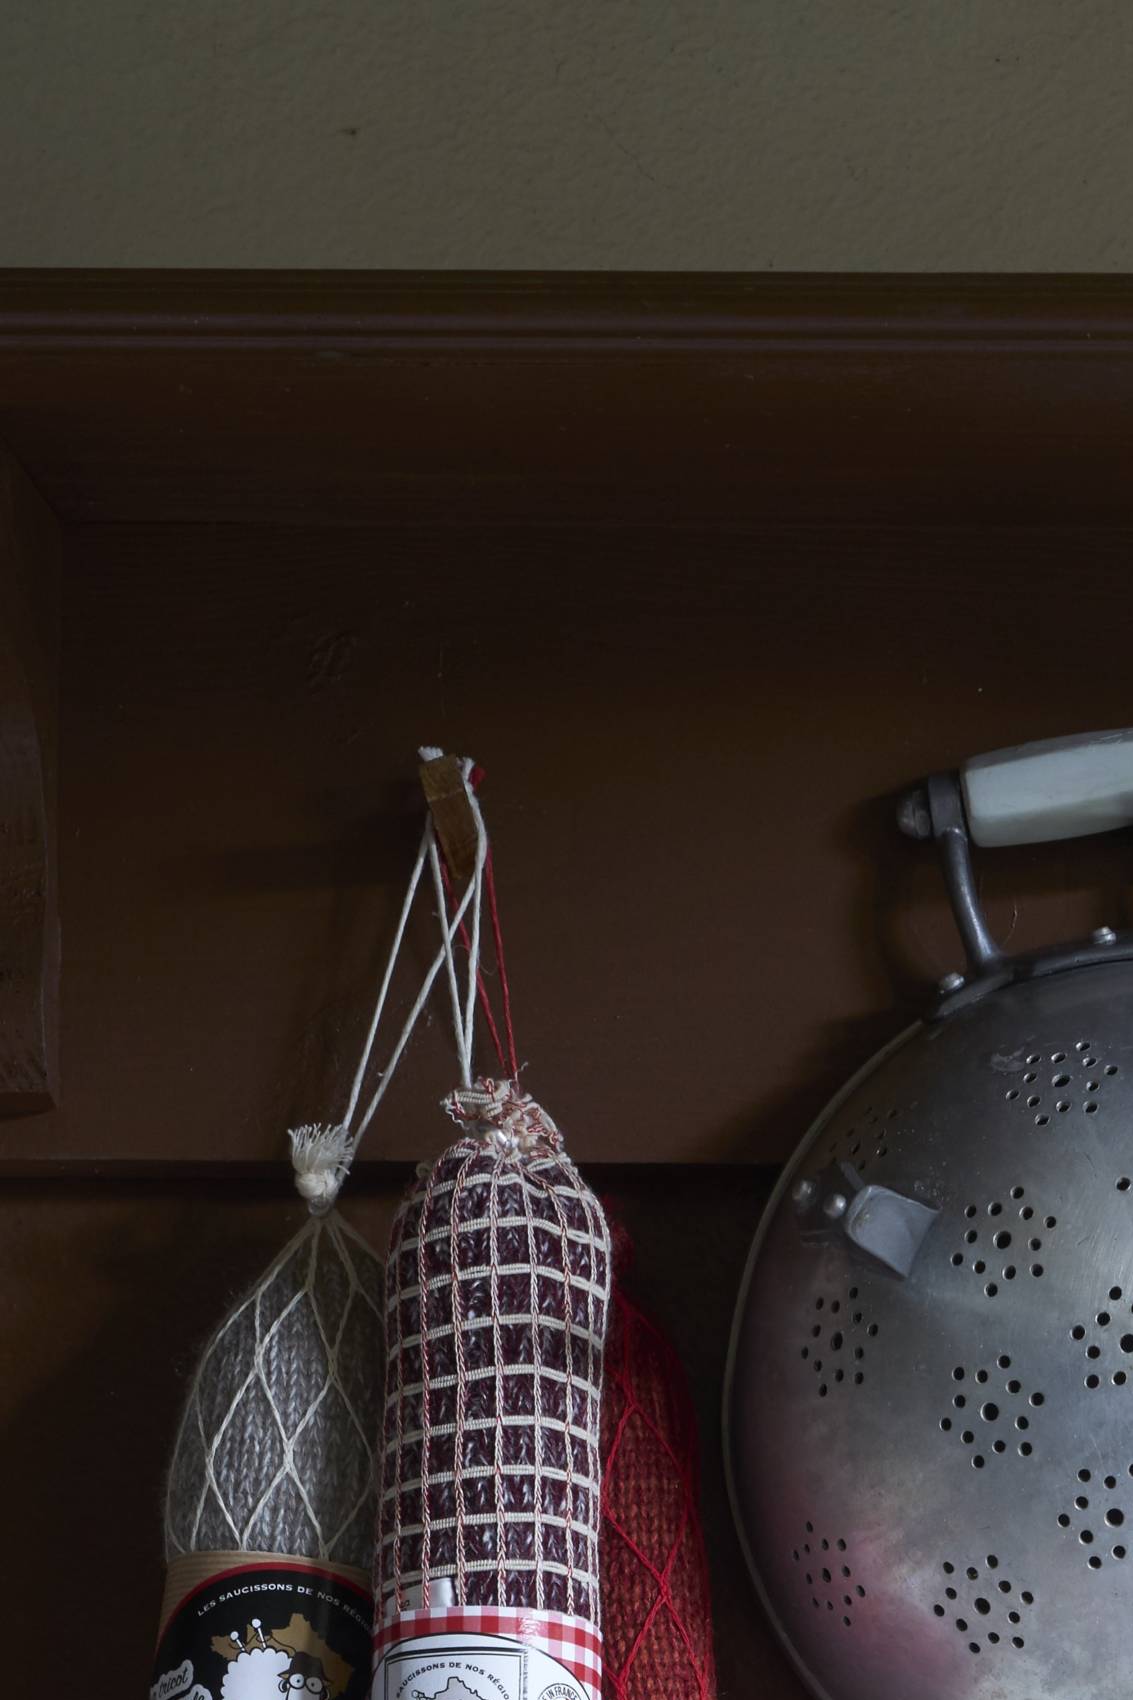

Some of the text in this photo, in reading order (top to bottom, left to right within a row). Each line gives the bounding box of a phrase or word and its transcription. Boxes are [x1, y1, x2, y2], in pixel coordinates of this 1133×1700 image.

[197, 1599, 217, 1617] LES
[219, 1583, 293, 1602] SAUCISSONS
[296, 1586, 314, 1596] DE
[317, 1591, 341, 1606] NOS
[465, 1663, 485, 1676] NOS
